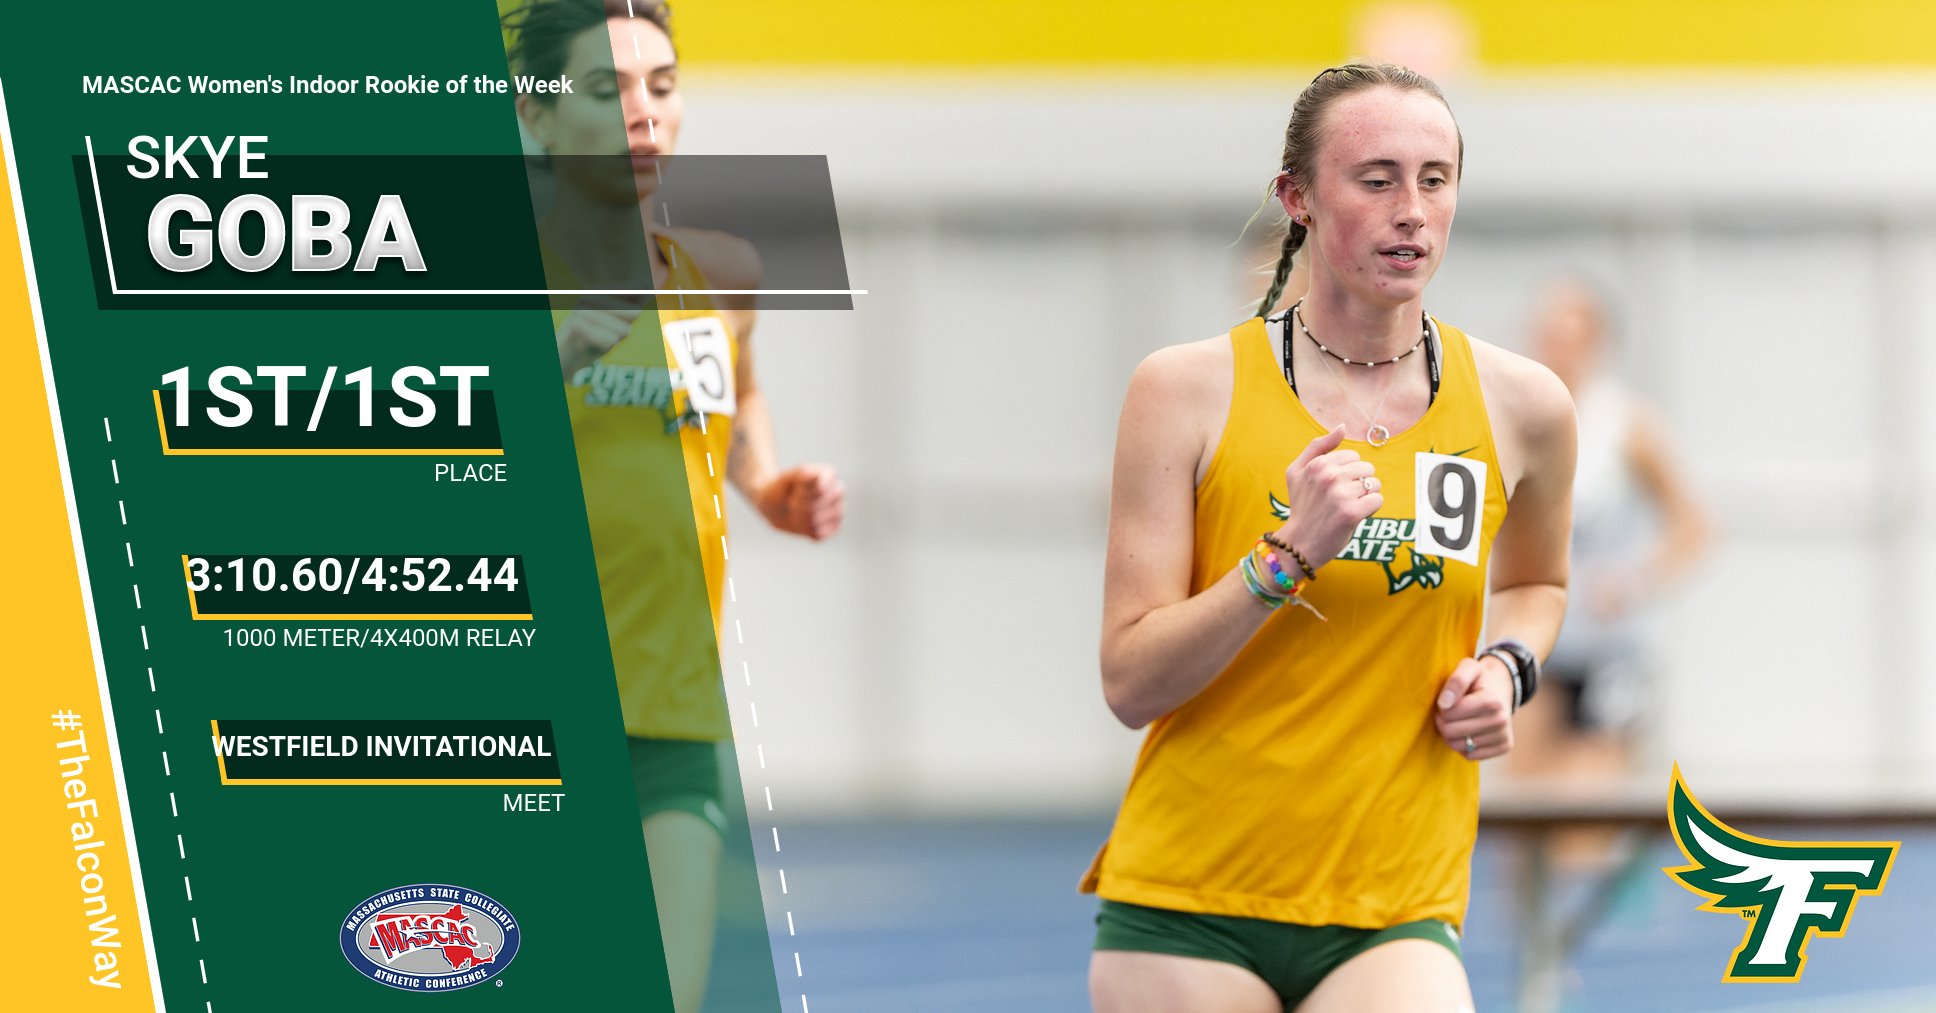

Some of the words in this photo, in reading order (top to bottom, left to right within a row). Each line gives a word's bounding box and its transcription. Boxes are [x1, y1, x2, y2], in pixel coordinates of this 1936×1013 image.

[684, 328, 725, 400] 5
[1428, 462, 1477, 551] 9
[1336, 538, 1400, 562] ATE
